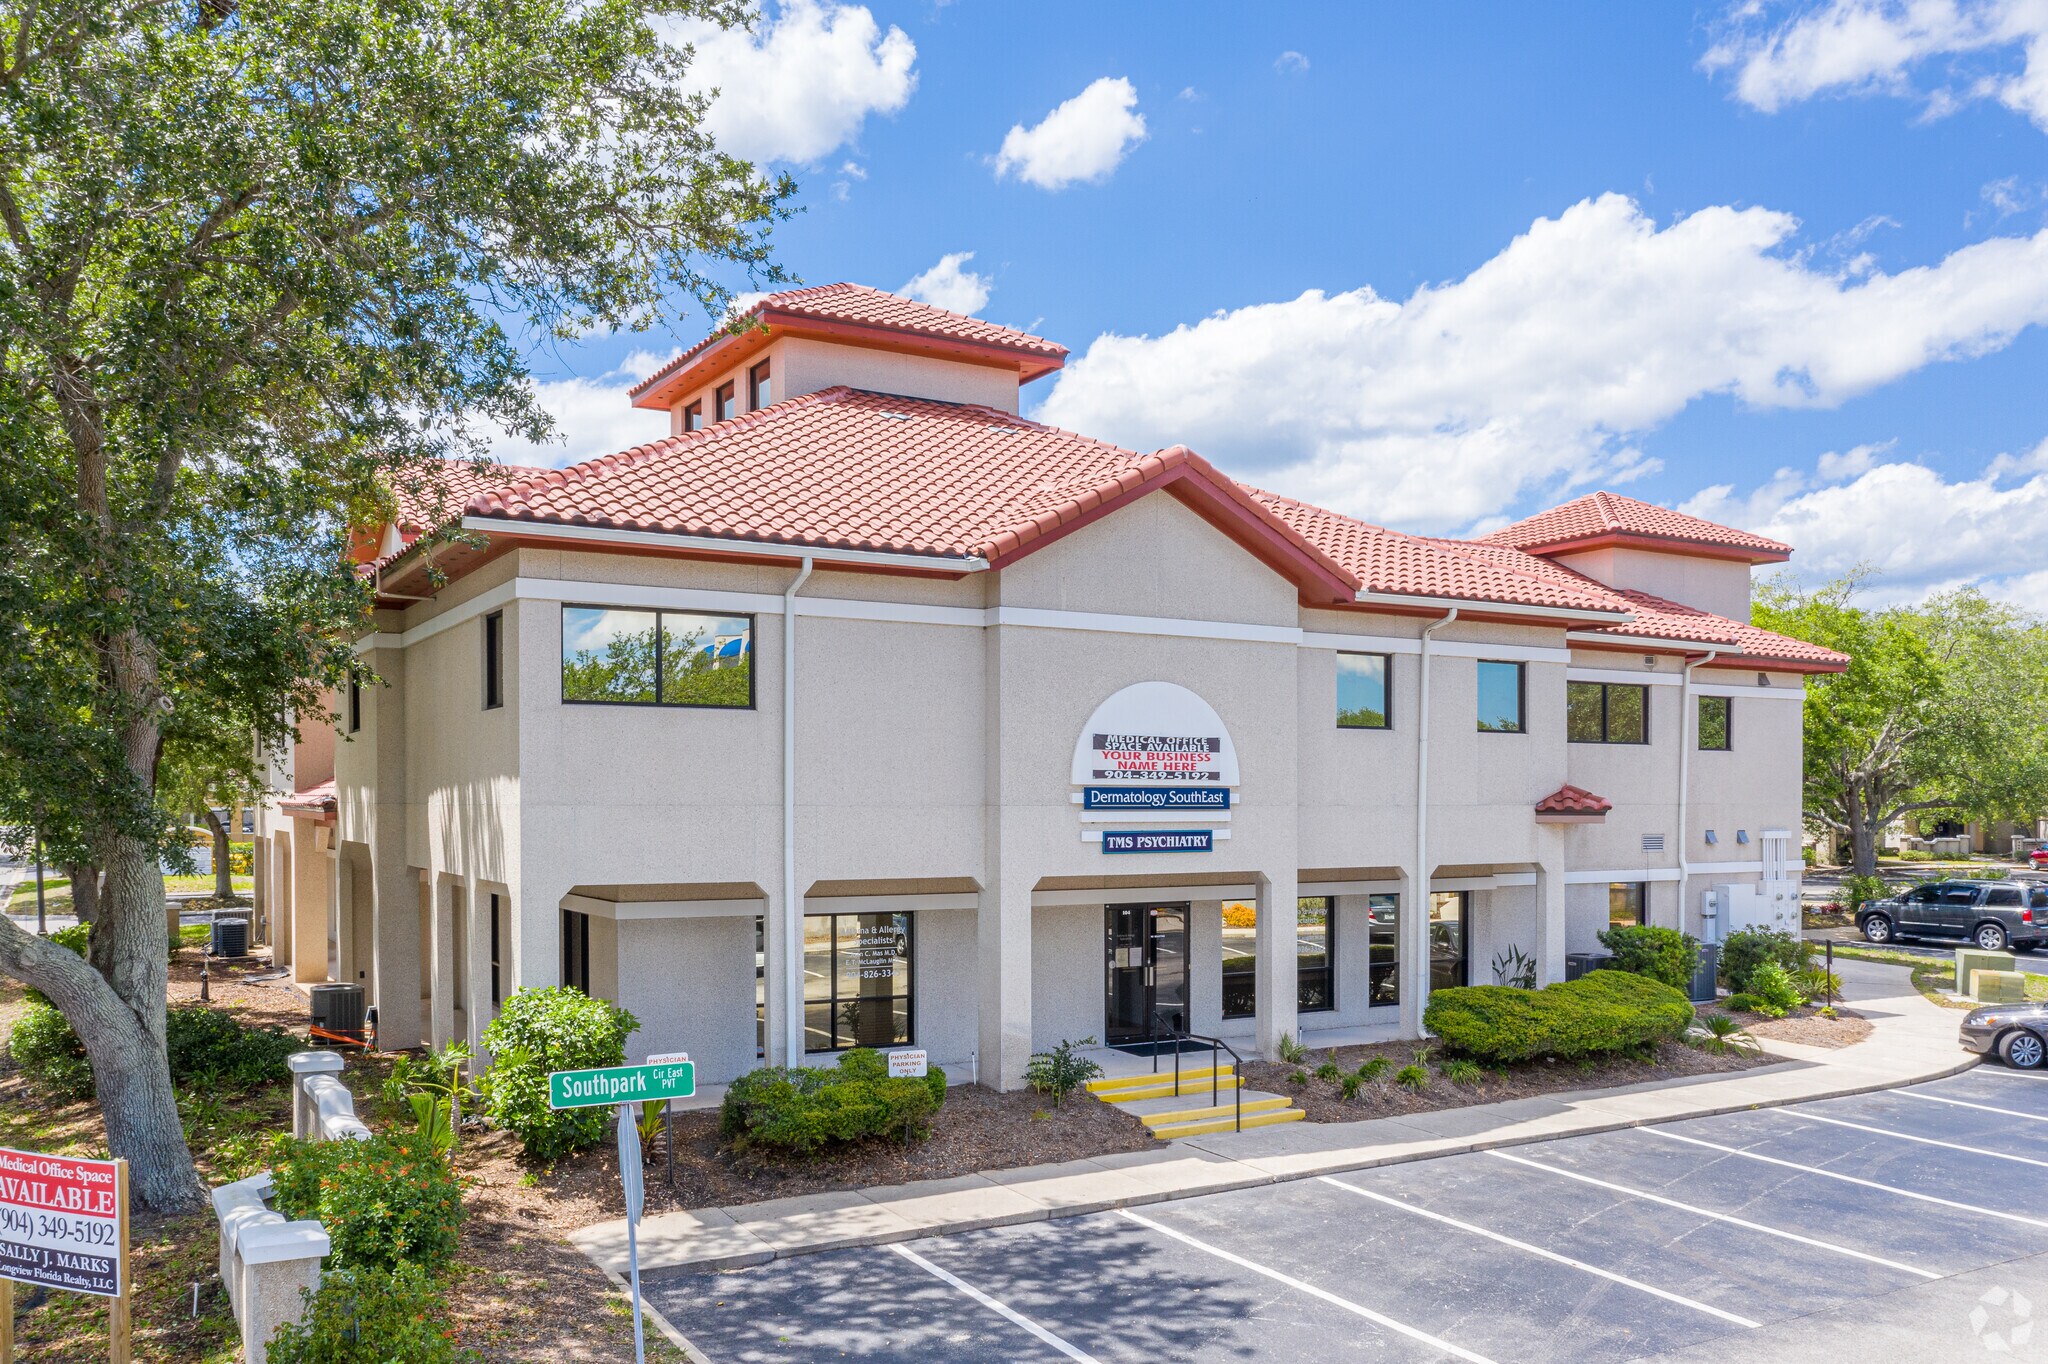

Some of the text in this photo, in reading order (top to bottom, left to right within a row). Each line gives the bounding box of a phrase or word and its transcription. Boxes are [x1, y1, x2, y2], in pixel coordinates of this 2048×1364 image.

[1106, 734, 1208, 745] MEDICAL OFFICE
[1104, 742, 1210, 753] SPACE AVAILABLE
[1102, 751, 1211, 762] YOUR BUSINESS
[1117, 761, 1197, 771] NAME HERE
[1104, 770, 1209, 780] 904-349-5192
[1090, 790, 1224, 806] Dermatology SouthEast
[1107, 835, 1209, 849] TMS PSYCHIATRY
[871, 926, 878, 934] &
[879, 925, 906, 935] Allergy
[648, 1056, 687, 1065] PHYSICIAN
[890, 1053, 926, 1061] PHYSICIAN
[892, 1060, 922, 1068] PARKING
[899, 1067, 917, 1075] ONLY
[562, 1067, 683, 1099] Southpark Cir East
[661, 1078, 676, 1090] PVT
[0, 1155, 112, 1186] Medical Office Space
[37, 1214, 115, 1247] 349-5192
[0, 1242, 110, 1274] SALLY J. MARKS
[33, 1267, 62, 1282] Florida
[63, 1273, 92, 1289] Realty,
[93, 1278, 114, 1290] LLC
